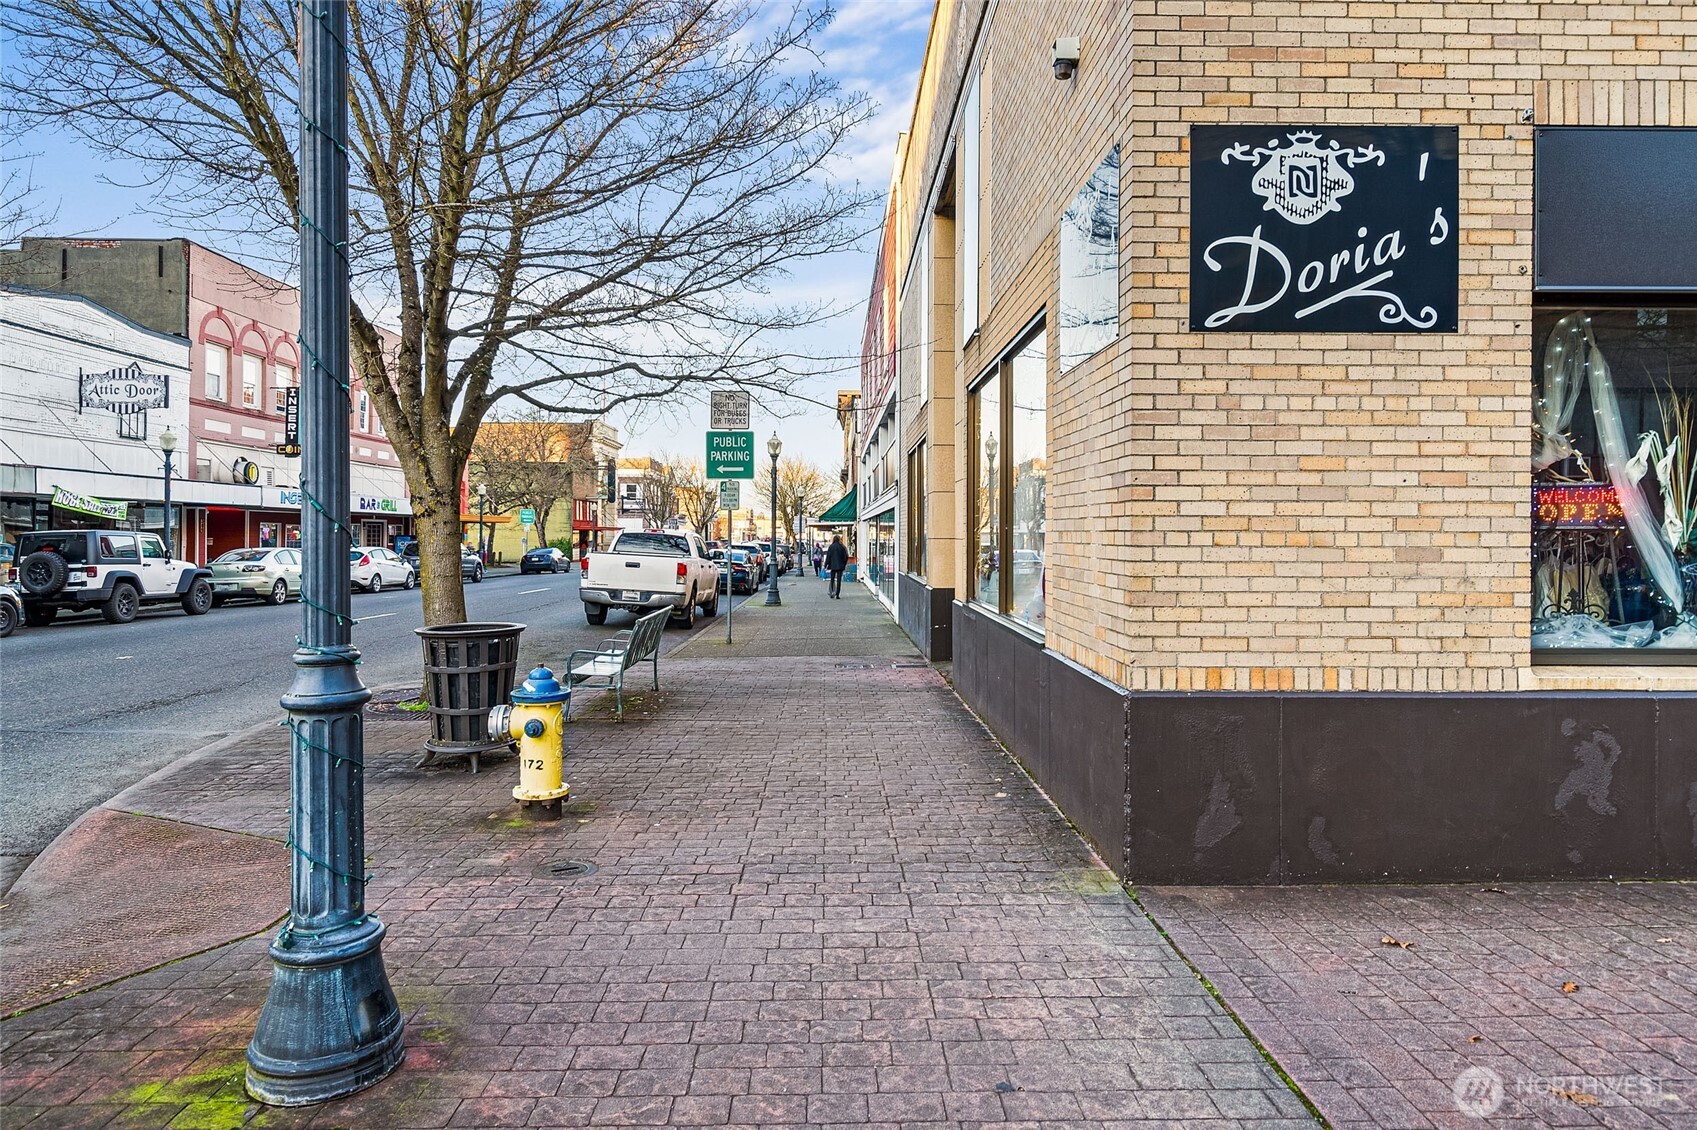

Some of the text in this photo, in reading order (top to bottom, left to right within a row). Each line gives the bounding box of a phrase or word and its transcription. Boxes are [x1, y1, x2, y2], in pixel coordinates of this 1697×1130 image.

[88, 383, 159, 398] Attic Door
[725, 394, 735, 402] NO
[713, 401, 747, 410] RIGHT TURN
[287, 388, 297, 440] INSERT
[713, 409, 725, 417] FOR
[713, 417, 747, 425] OR TRUCKS
[713, 436, 747, 448] PUBLIC
[710, 450, 750, 462] PARKING
[721, 482, 726, 491] 4
[1538, 489, 1620, 503] WELCOM
[360, 497, 376, 510] BAR
[381, 499, 398, 512] GRILL
[1539, 503, 1625, 521] OPEN
[523, 759, 544, 771] 172
